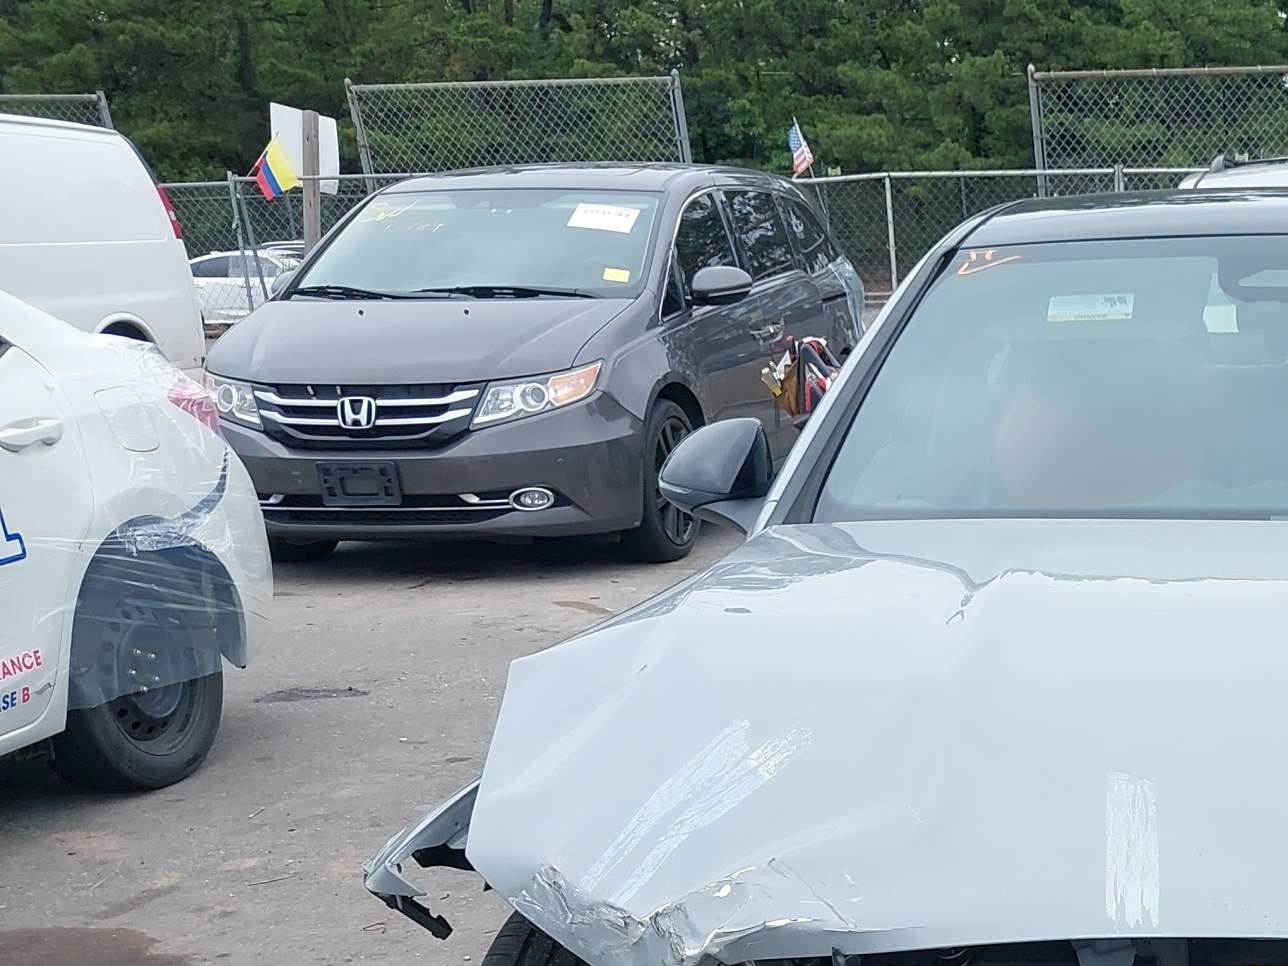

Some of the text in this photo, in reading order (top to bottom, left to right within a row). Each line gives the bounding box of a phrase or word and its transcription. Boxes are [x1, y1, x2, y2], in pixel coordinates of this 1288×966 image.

[0, 649, 42, 680] ANCE
[0, 686, 31, 712] SE B
